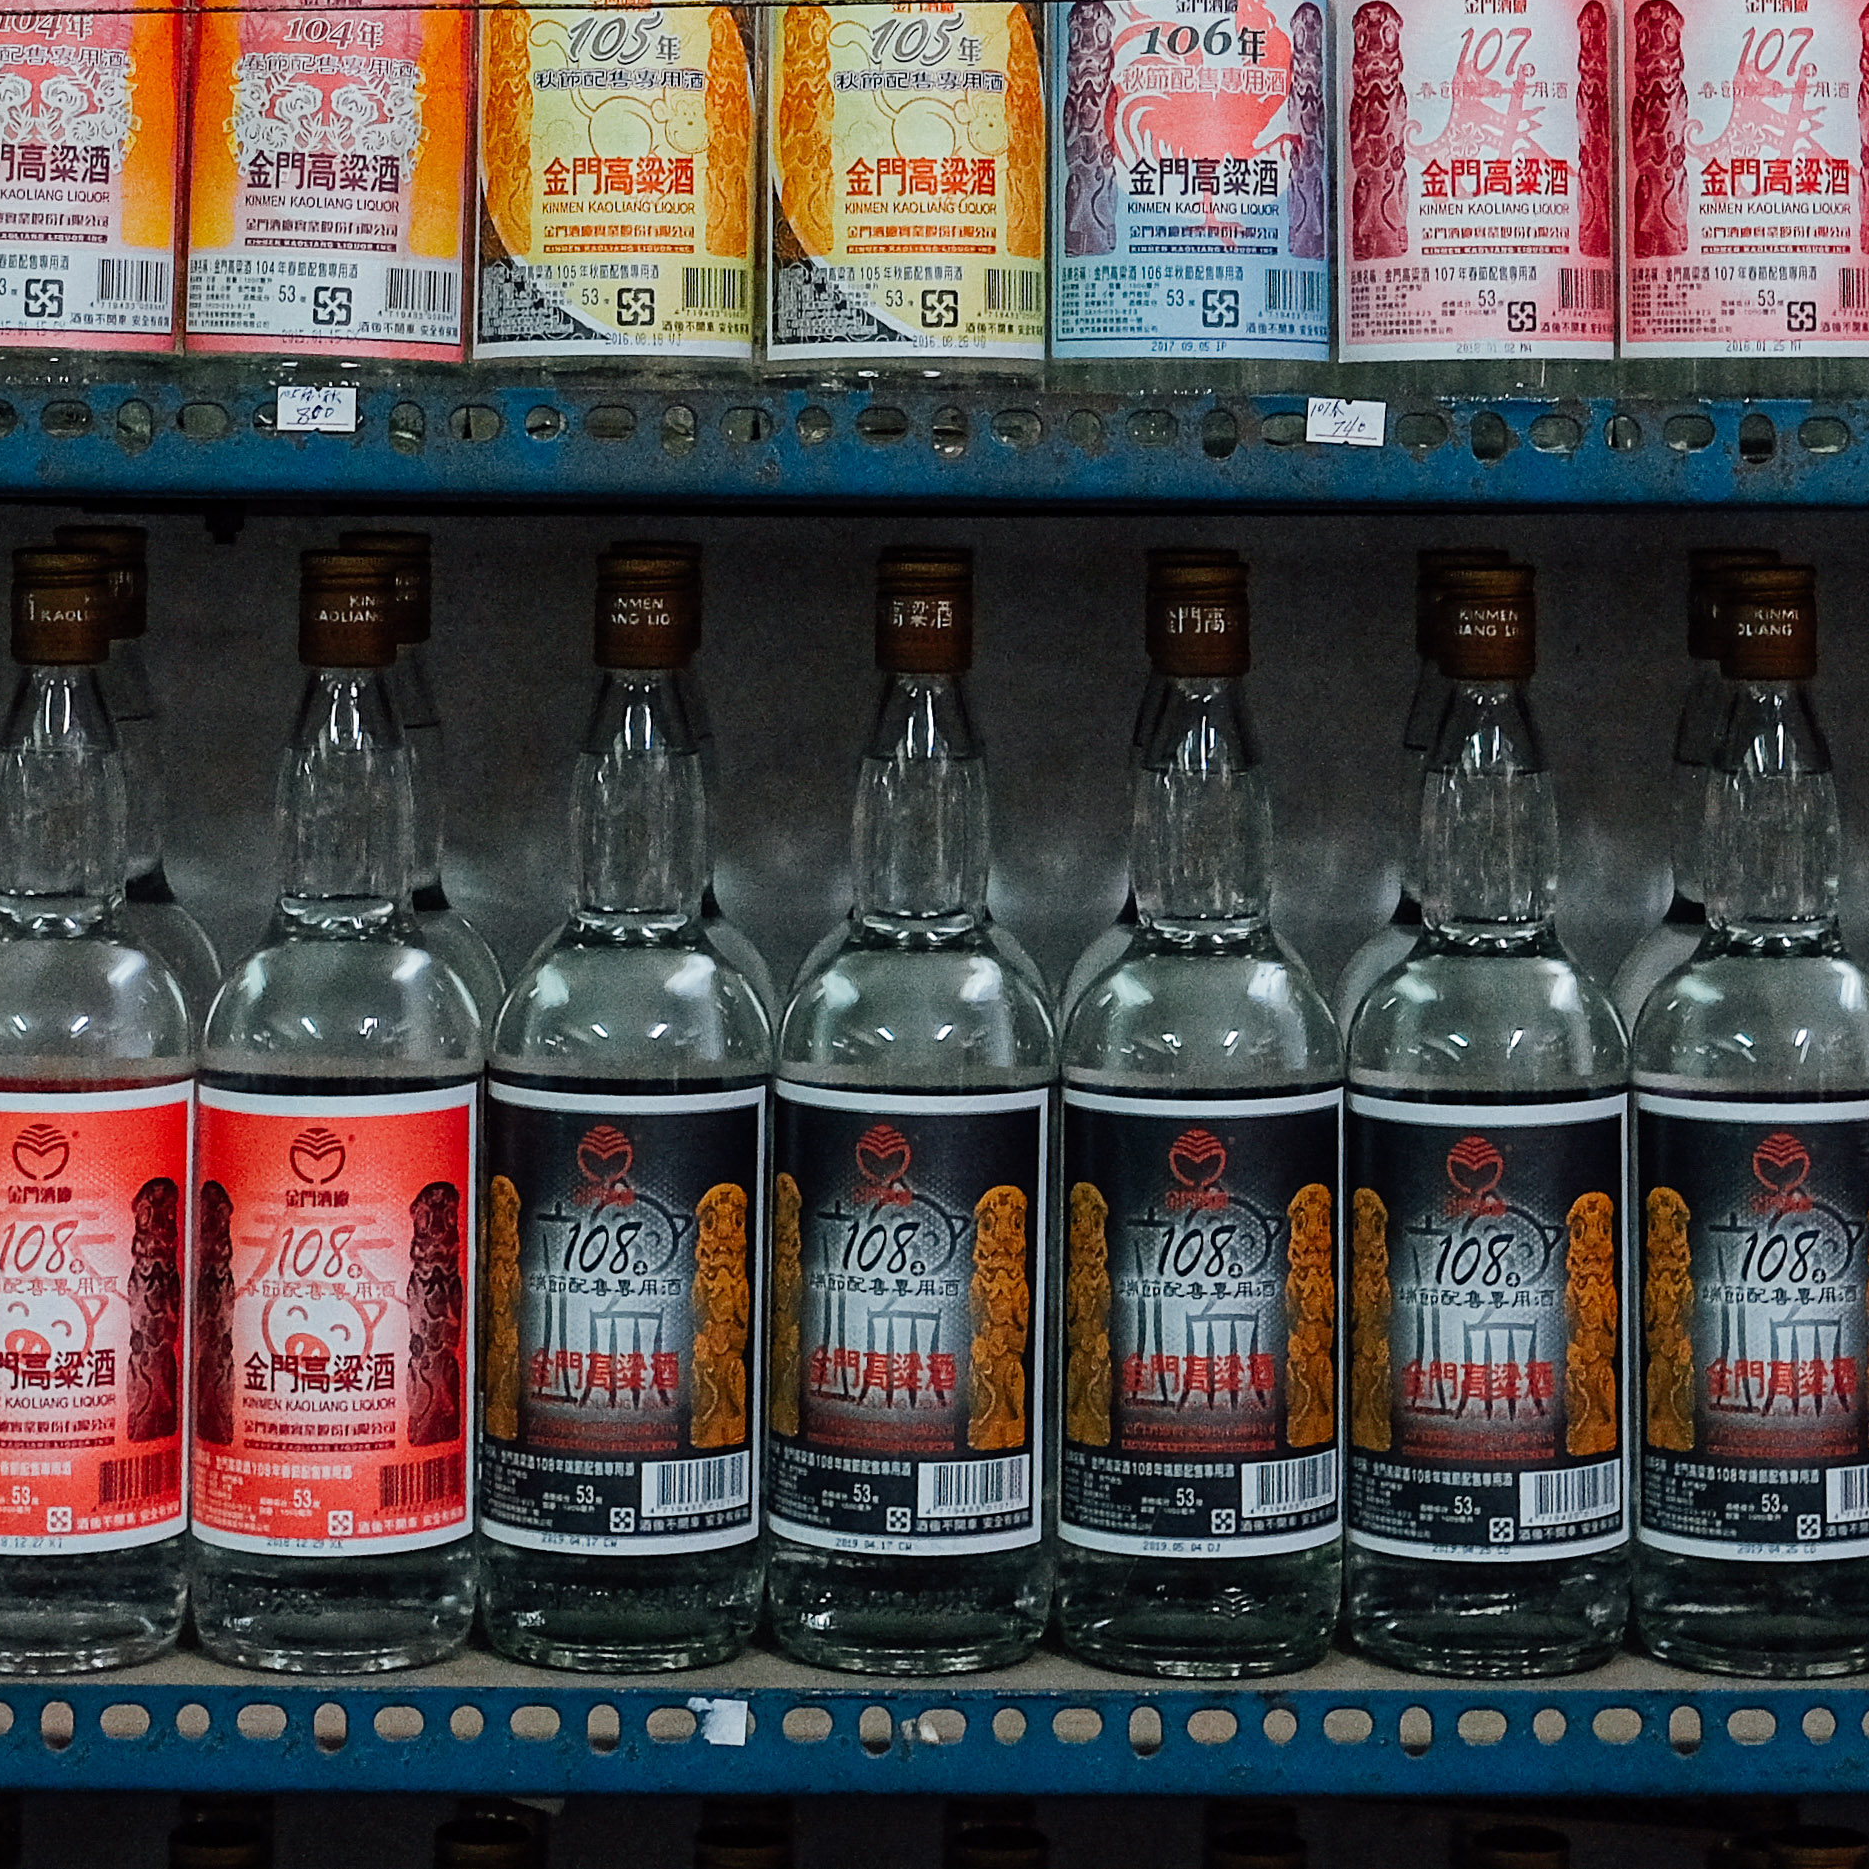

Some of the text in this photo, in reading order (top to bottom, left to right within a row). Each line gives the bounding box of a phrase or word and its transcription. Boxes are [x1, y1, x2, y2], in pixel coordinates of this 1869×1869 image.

[1141, 17, 1265, 63] 106年
[246, 150, 400, 193] 金門高粱酒
[543, 158, 695, 197] 金門高粱酒
[846, 157, 996, 197] 金門高粱酒
[1128, 159, 1279, 197] 金門高粱酒
[1420, 159, 1569, 197] 金門高粱酒
[1701, 159, 1850, 196] 金門高粱酒
[0, 187, 63, 203] KAOLIANG
[68, 190, 110, 205] LIQUOR
[542, 202, 696, 215] KINMEN KAOLIANG LIQUOR
[1127, 202, 1279, 217] KINMEN KAOLIANG LIQUOR
[1699, 202, 1851, 215] KINMEN KAOLIANG LIQUOR
[581, 290, 599, 307] 53
[1166, 289, 1184, 307] 53
[1478, 290, 1496, 307] 53
[244, 1353, 395, 1392] 金門高粱酒
